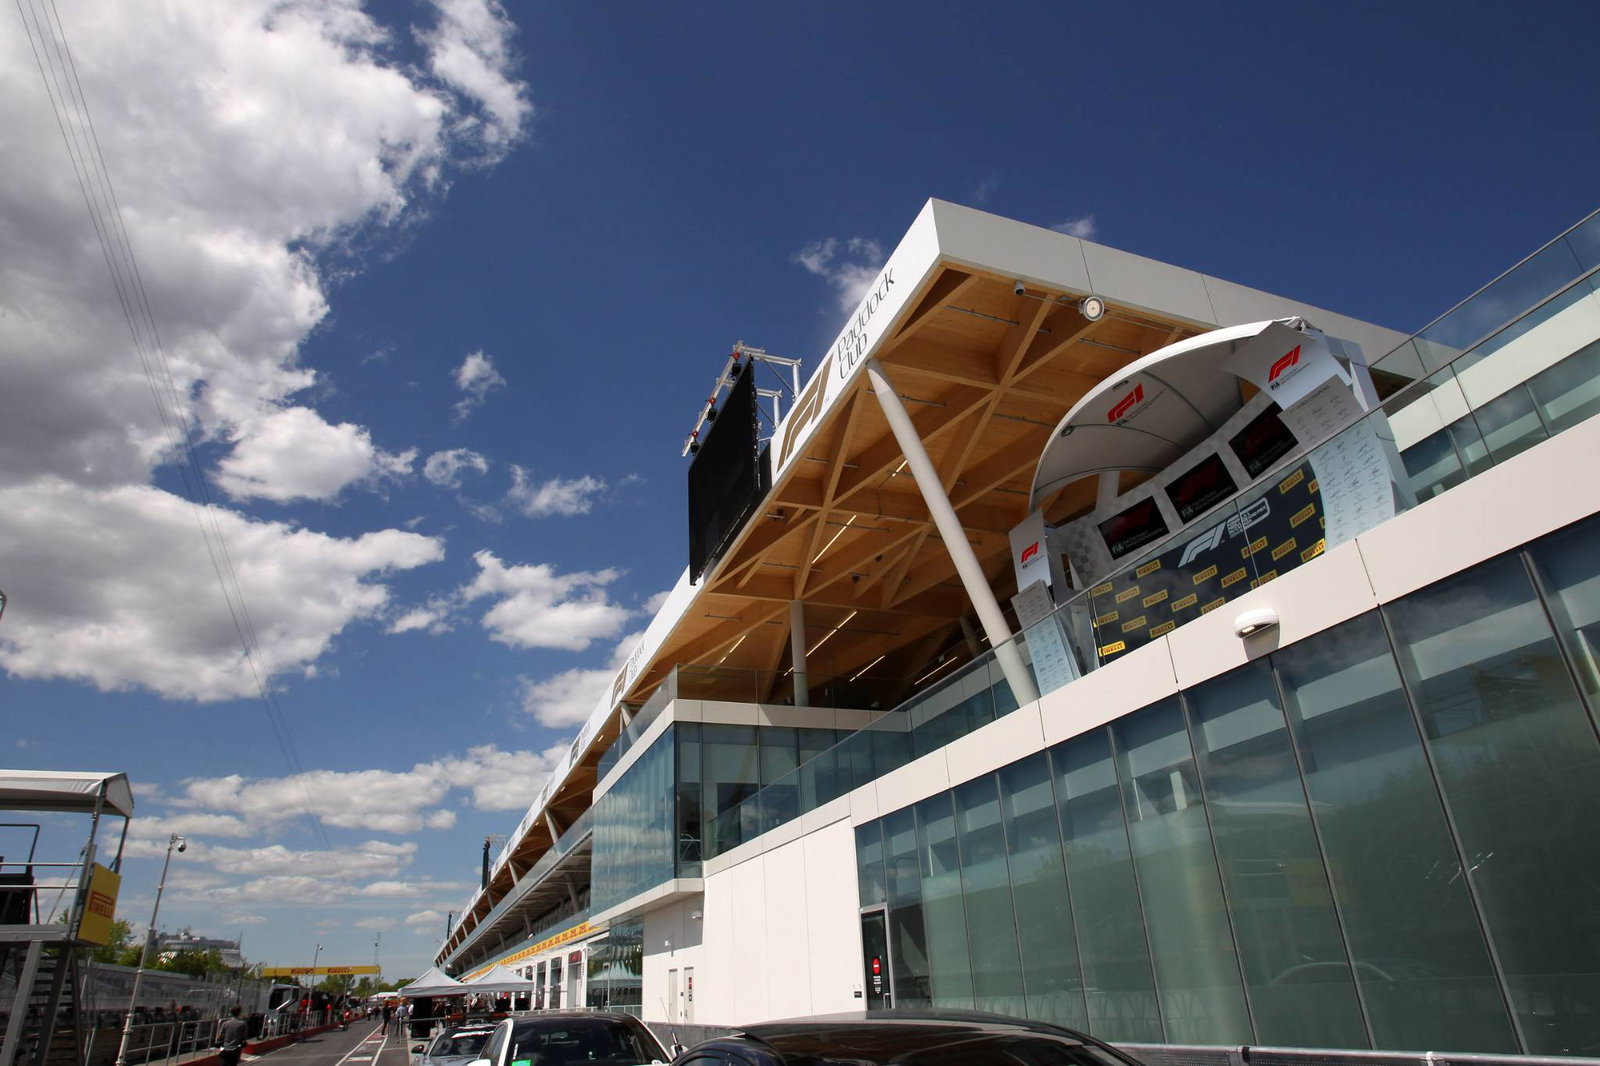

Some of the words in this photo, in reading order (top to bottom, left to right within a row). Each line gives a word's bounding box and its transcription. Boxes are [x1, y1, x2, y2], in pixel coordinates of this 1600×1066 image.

[837, 267, 895, 362] Paddock
[839, 332, 868, 380] Club
[1268, 344, 1301, 383] F1
[776, 351, 835, 474] F1
[1107, 383, 1144, 424] F1
[1021, 541, 1039, 563] F1
[1178, 520, 1227, 568] F1
[88, 891, 116, 919] PIRELLI
